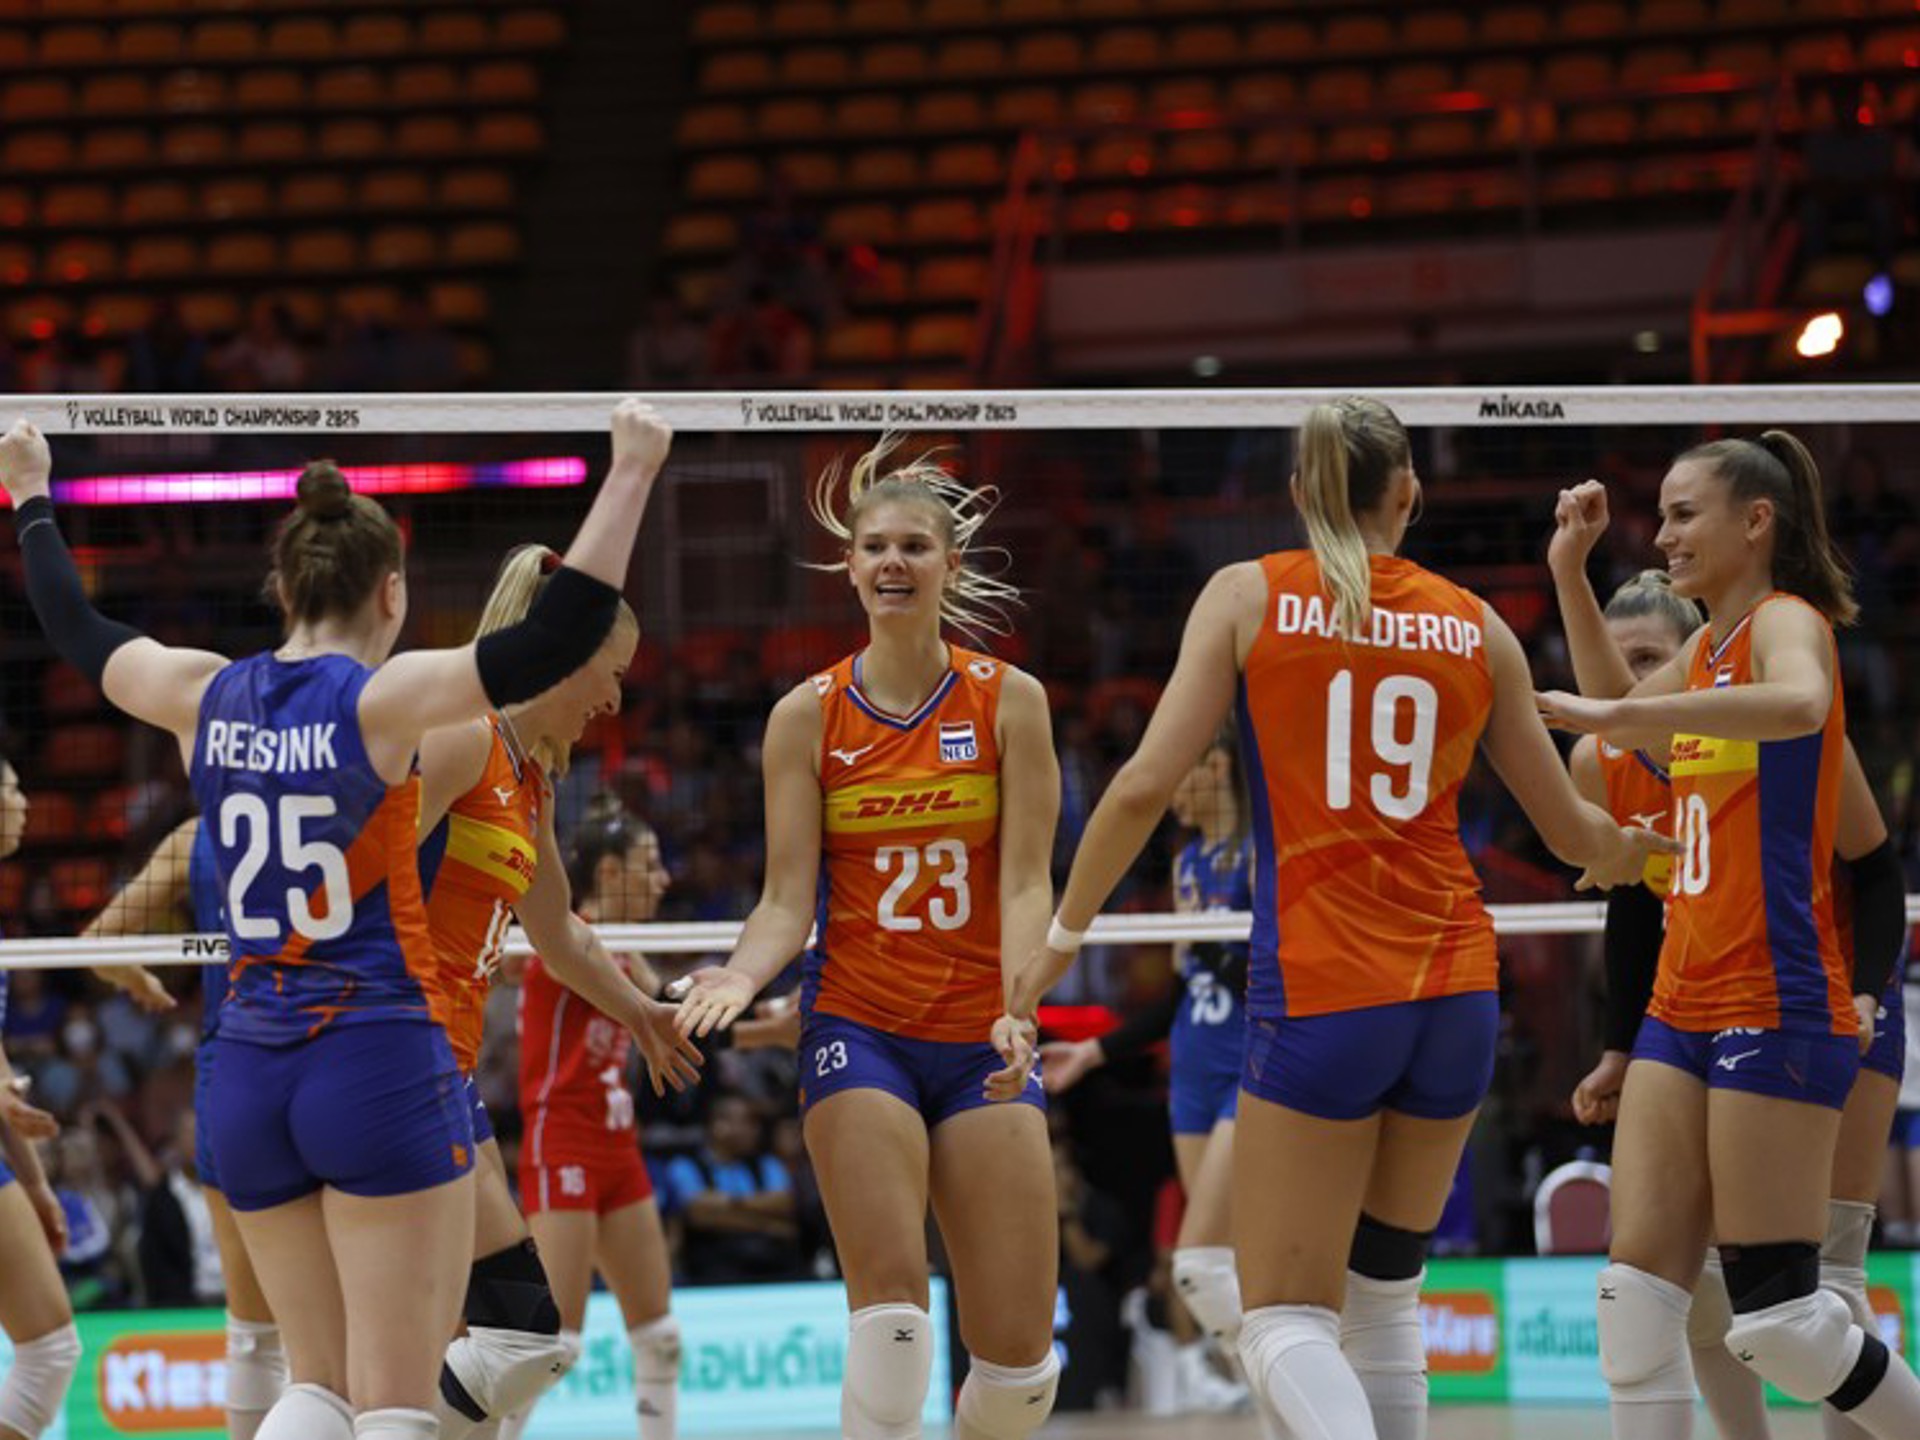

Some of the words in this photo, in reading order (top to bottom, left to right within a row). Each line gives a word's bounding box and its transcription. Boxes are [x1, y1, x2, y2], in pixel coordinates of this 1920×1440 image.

[84, 408, 165, 426] VOLLEYBALL
[170, 408, 218, 426] WORLD
[224, 408, 321, 427] CHAMPIONSHIP
[758, 404, 834, 423] VOLLEYBALL
[840, 404, 884, 422] WORLD
[1326, 669, 1438, 821] 19
[857, 790, 961, 820] DHL
[220, 792, 353, 941] 25
[875, 839, 971, 931] 23
[815, 1040, 848, 1077] 23
